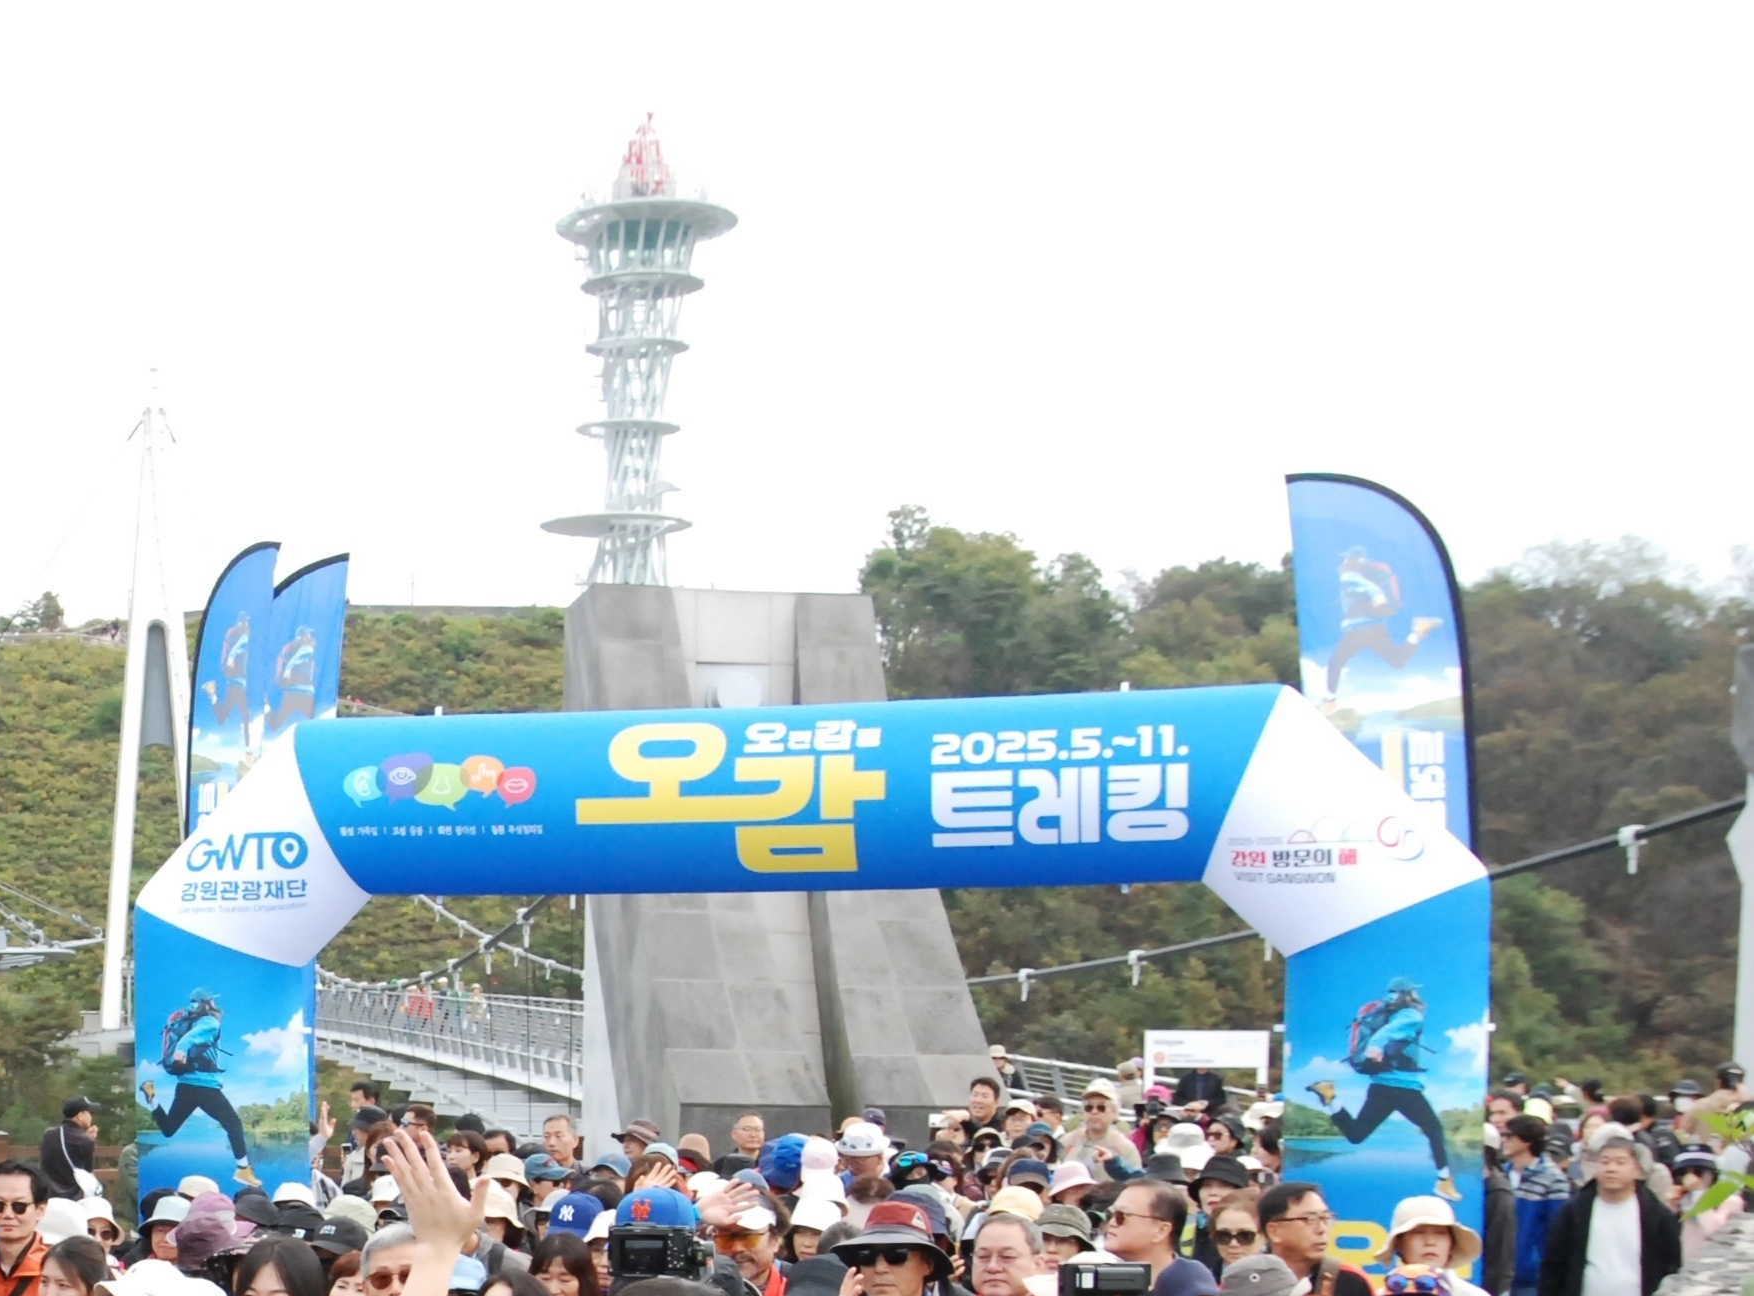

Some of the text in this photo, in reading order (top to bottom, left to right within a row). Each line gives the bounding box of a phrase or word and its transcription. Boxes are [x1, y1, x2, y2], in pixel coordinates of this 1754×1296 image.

[931, 724, 1190, 765] 2025.5.~11.
[576, 722, 886, 873] 오감
[931, 763, 1190, 848] 트레킹
[186, 831, 309, 872] GWTO
[1230, 849, 1267, 868] 강원
[1273, 848, 1332, 868] 방문의
[180, 879, 308, 902] 강원관광재단
